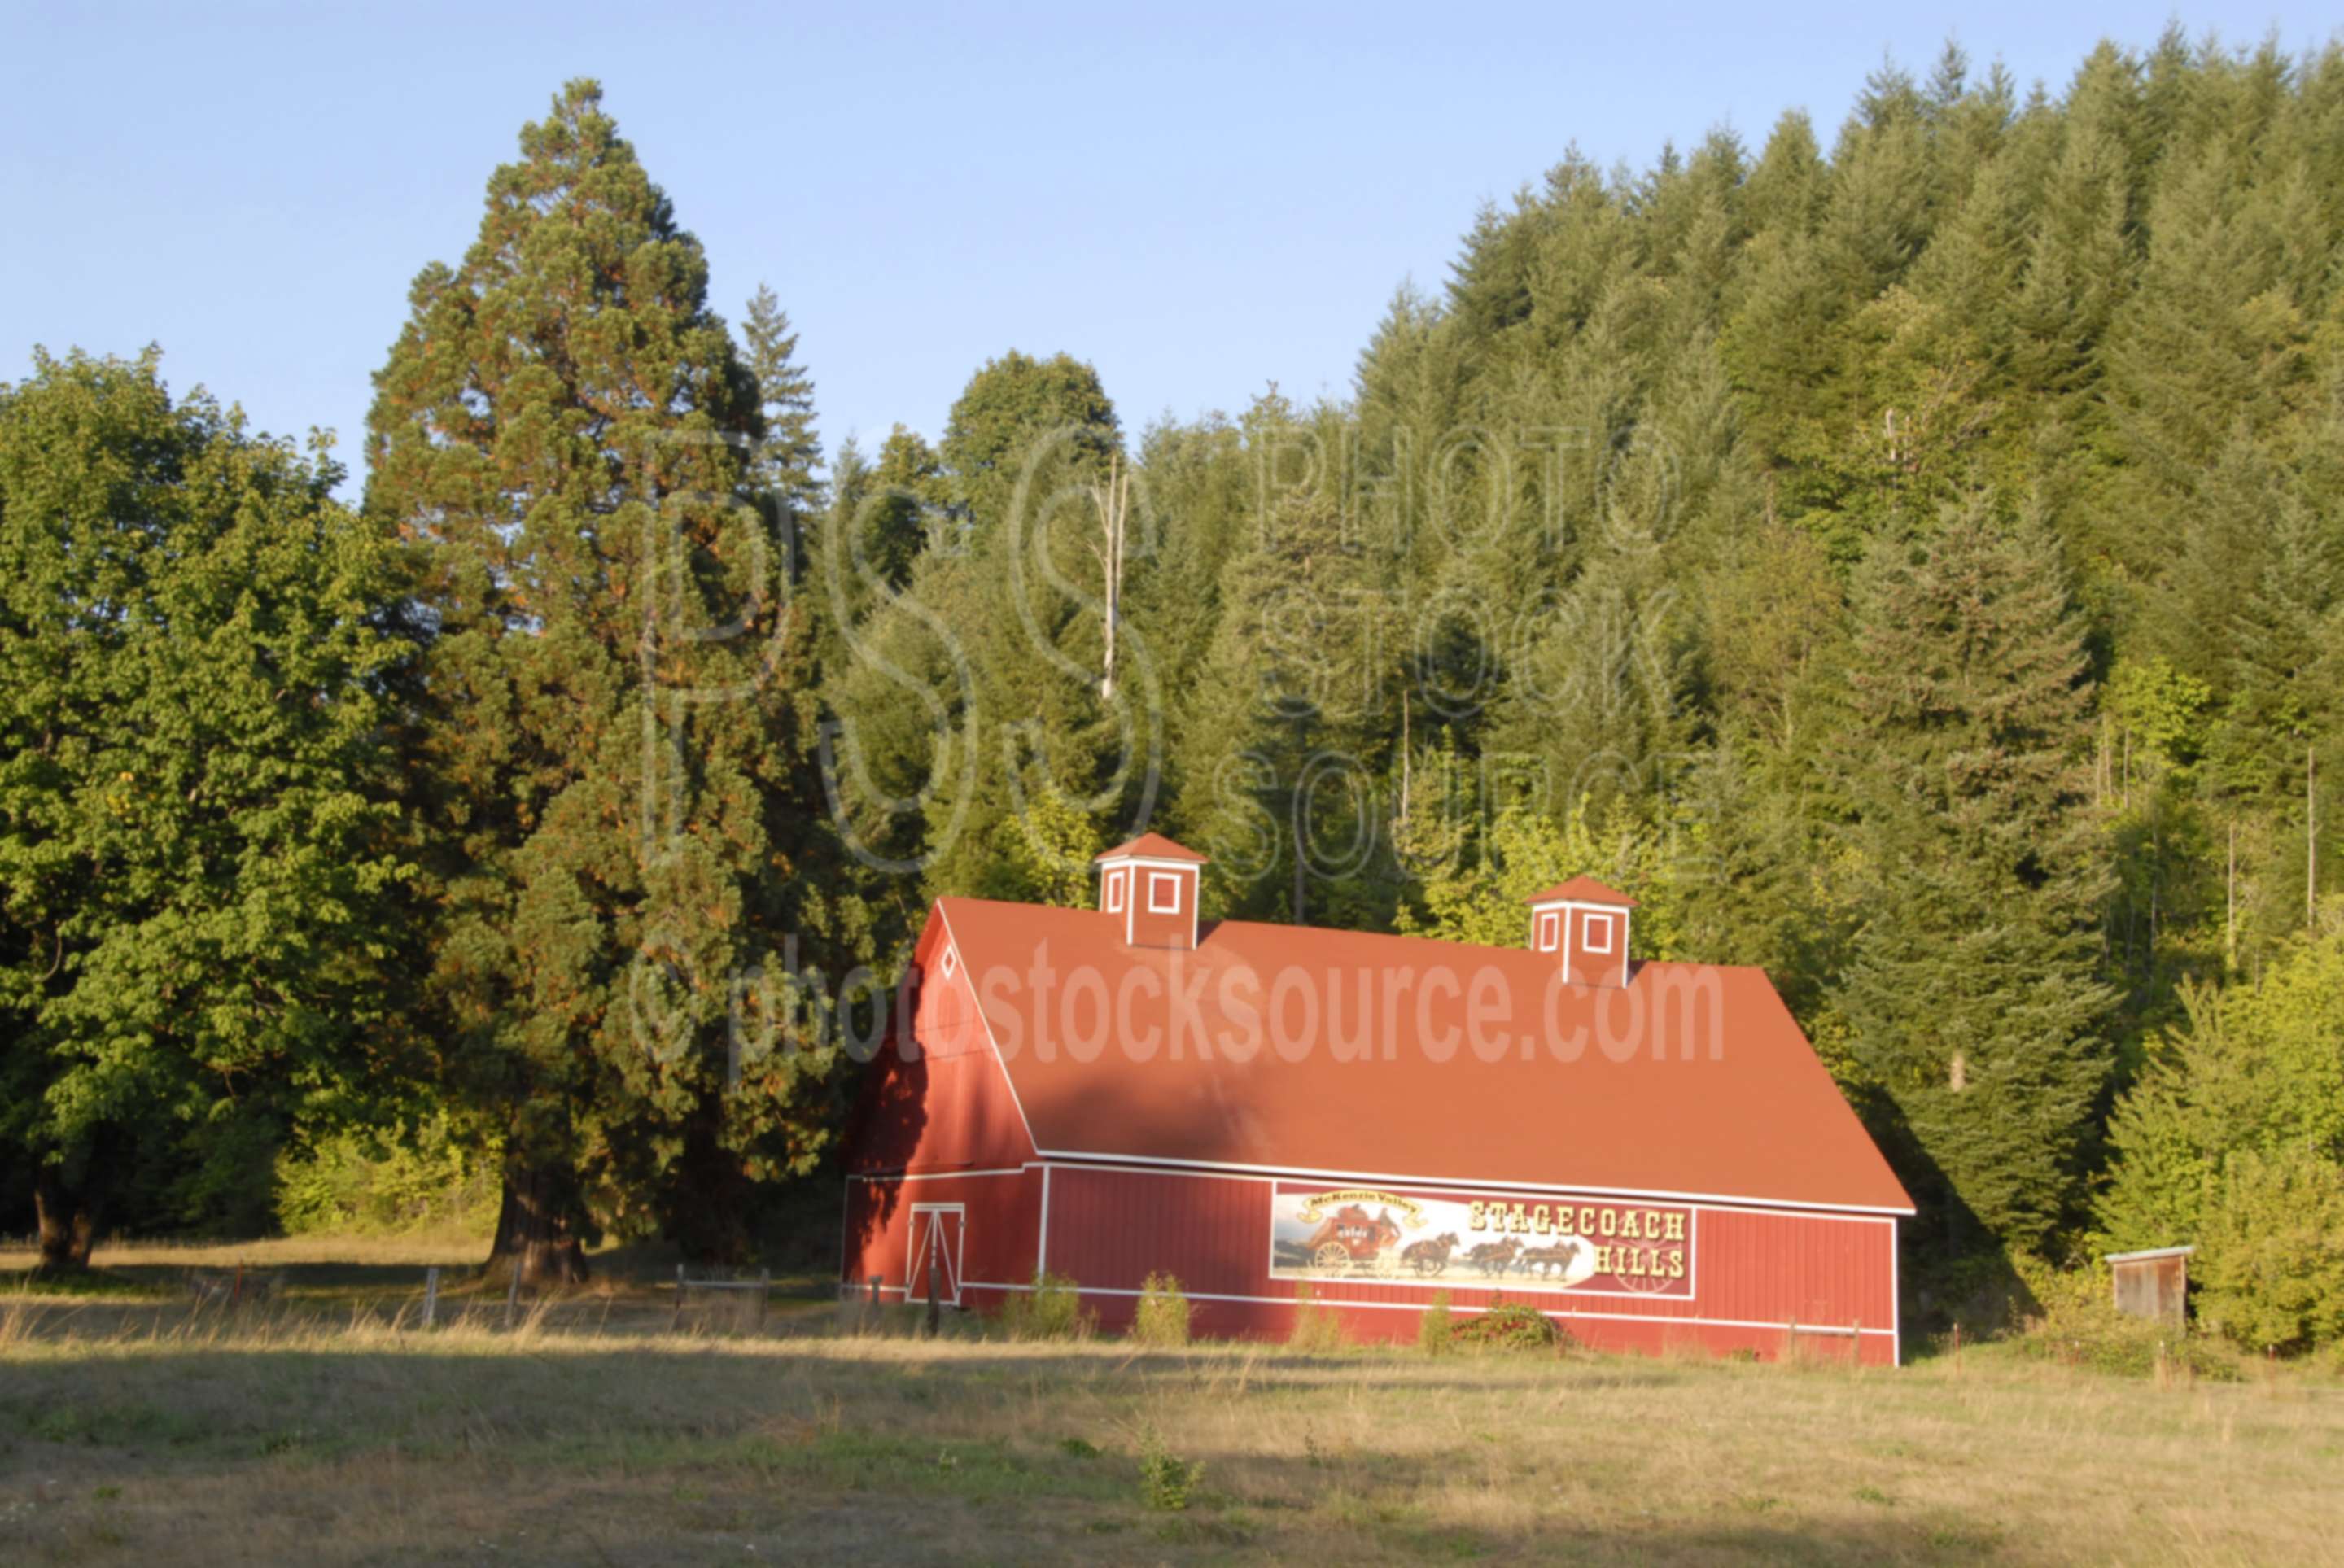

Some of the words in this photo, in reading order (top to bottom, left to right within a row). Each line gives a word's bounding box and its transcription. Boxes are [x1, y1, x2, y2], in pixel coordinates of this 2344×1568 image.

[1310, 1191, 1376, 1207] McKenzie
[1378, 1193, 1418, 1213] Valley
[1469, 1200, 1686, 1241] STAGECOACH
[1594, 1245, 1685, 1278] HILLS
